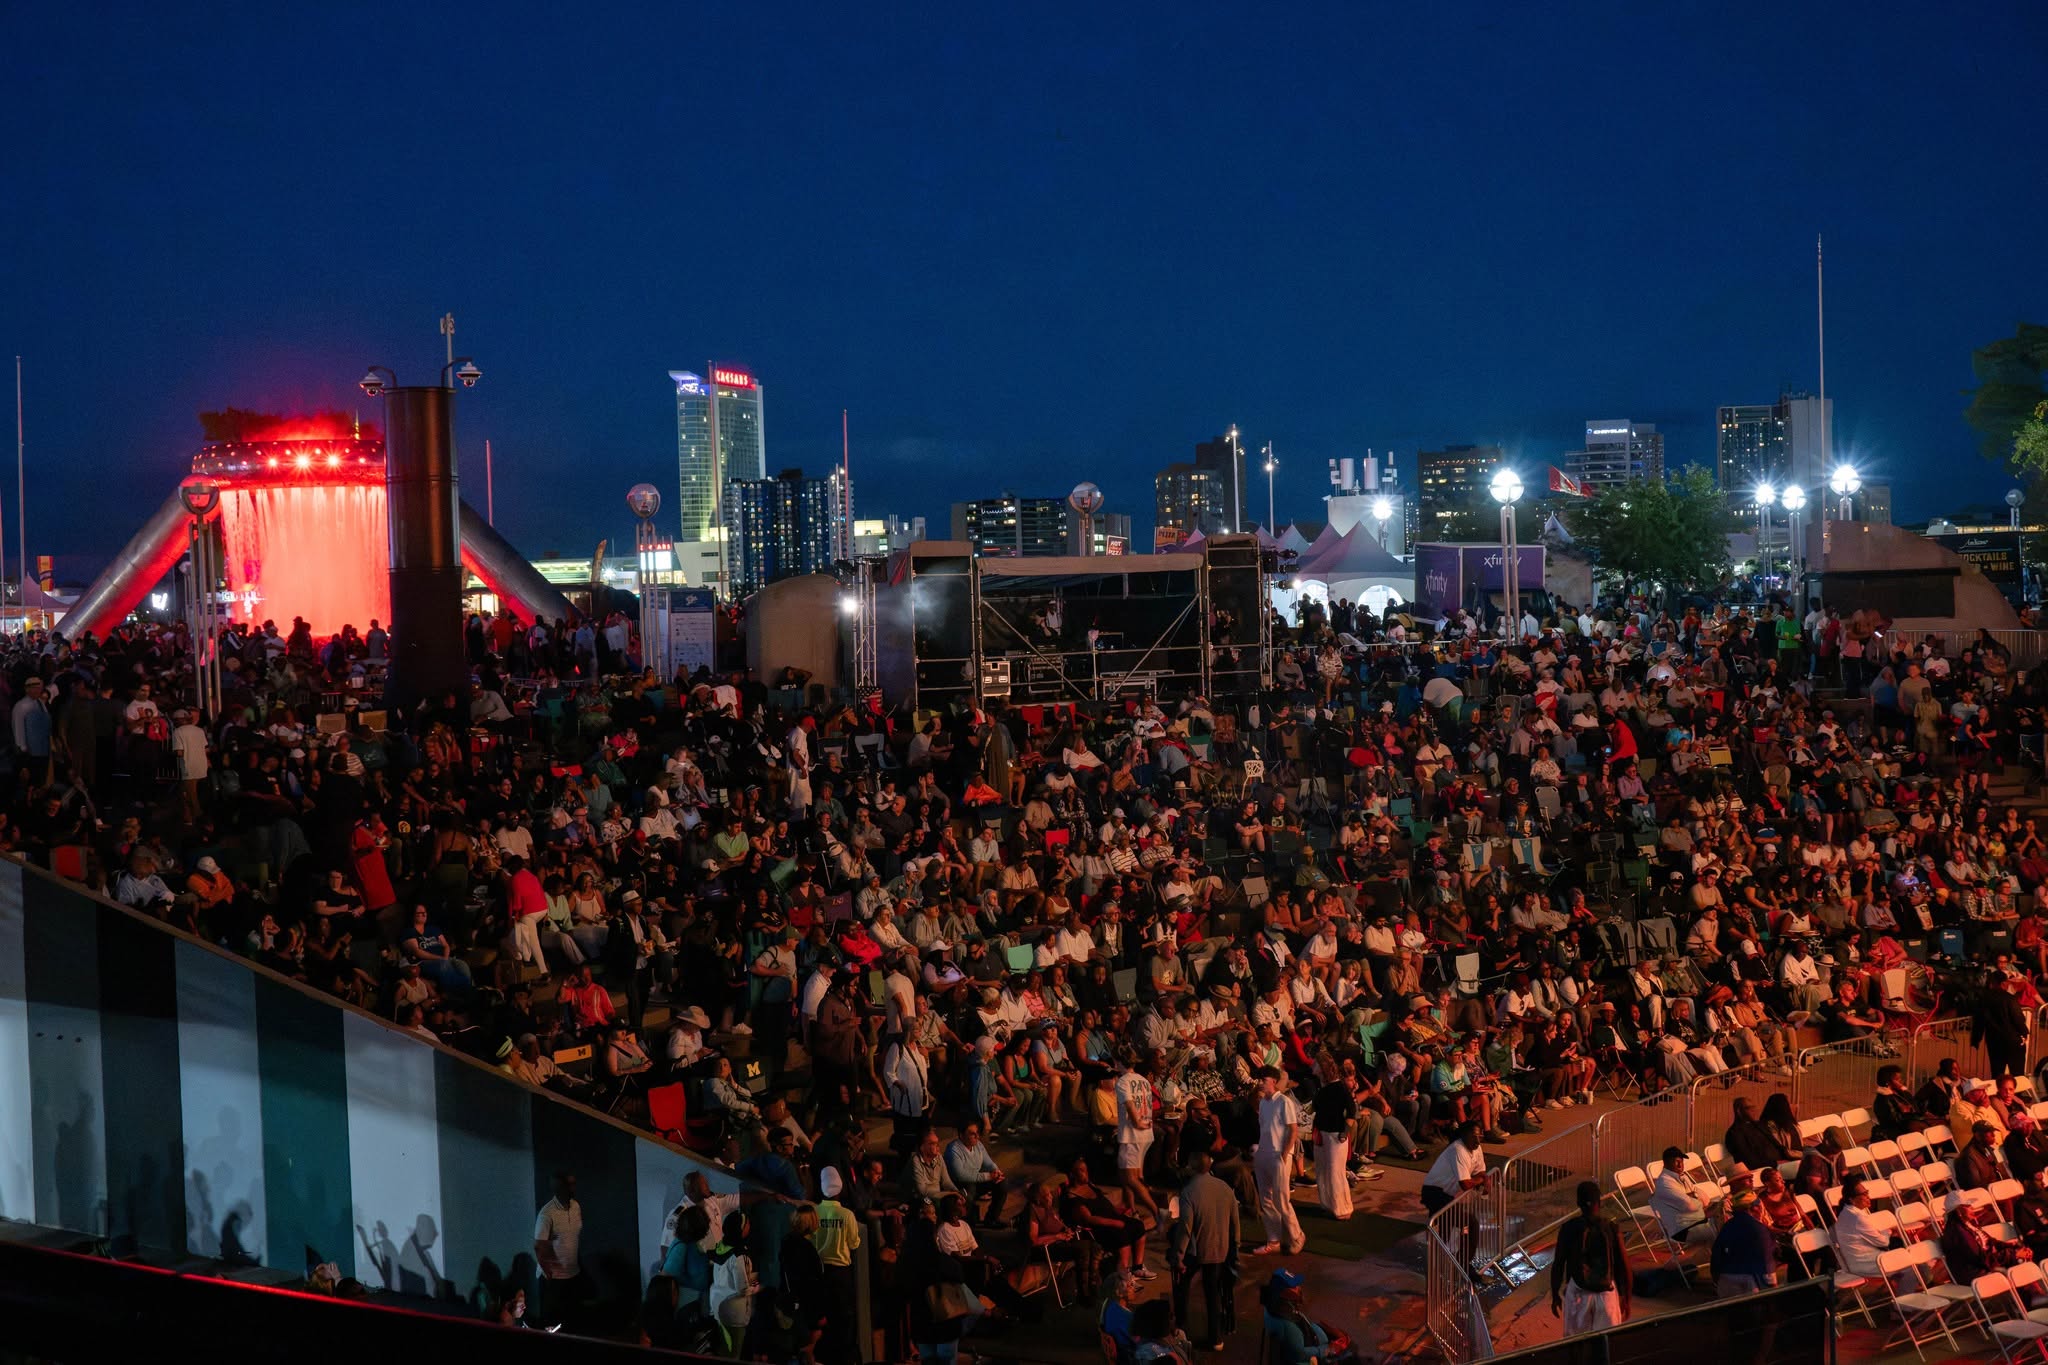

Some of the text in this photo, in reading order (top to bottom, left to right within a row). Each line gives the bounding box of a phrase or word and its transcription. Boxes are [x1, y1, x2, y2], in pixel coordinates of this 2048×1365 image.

[715, 369, 749, 387] CAESARS
[1483, 553, 1522, 568] xfiny
[1990, 561, 2016, 572] WINE
[1425, 569, 1448, 598] xfinity
[746, 1060, 761, 1078] M
